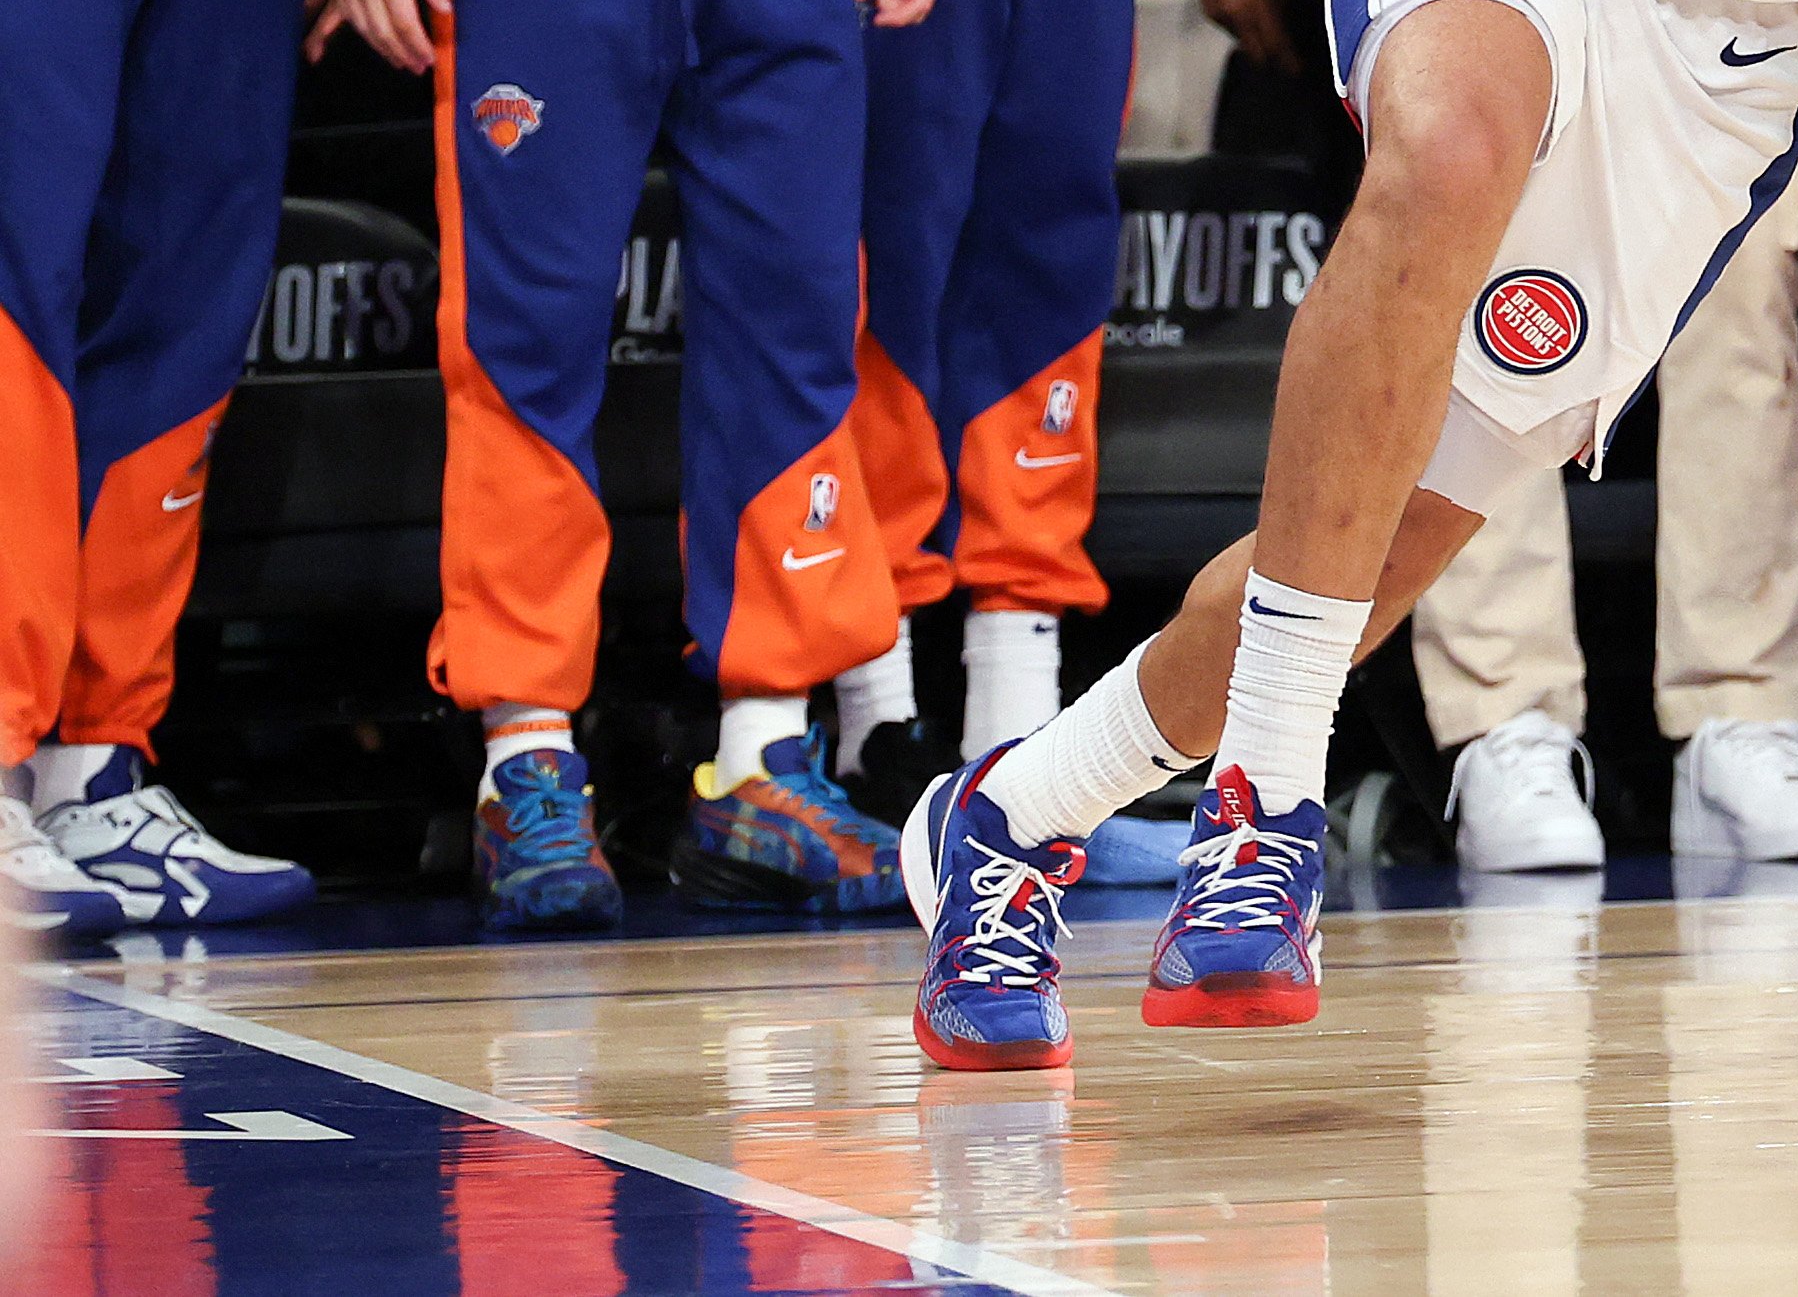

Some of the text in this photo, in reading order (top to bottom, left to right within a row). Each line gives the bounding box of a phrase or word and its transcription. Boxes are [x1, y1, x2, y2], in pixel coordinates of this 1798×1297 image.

[1112, 209, 1326, 310] AYOFFS
[246, 264, 413, 362] OFFS
[1496, 300, 1556, 356] PISTONS
[1510, 288, 1569, 342] DETROIT
